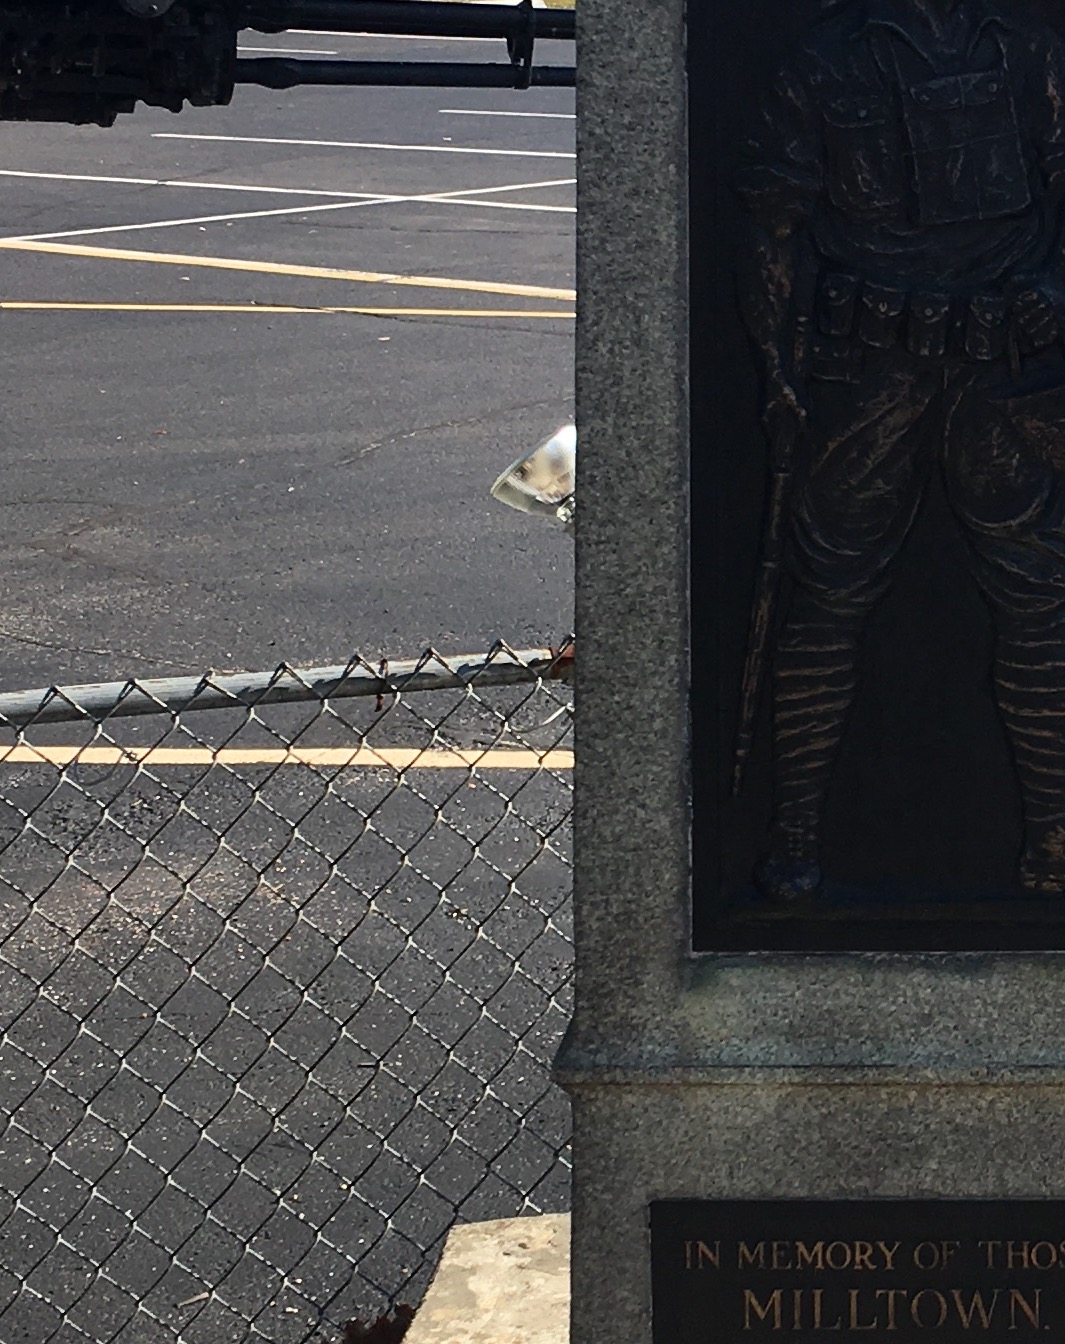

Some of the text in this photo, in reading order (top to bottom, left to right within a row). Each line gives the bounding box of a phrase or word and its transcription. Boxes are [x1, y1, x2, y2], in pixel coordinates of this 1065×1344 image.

[684, 1241, 721, 1270] IN
[737, 1240, 902, 1271] MEMORY
[914, 1241, 961, 1270] OF
